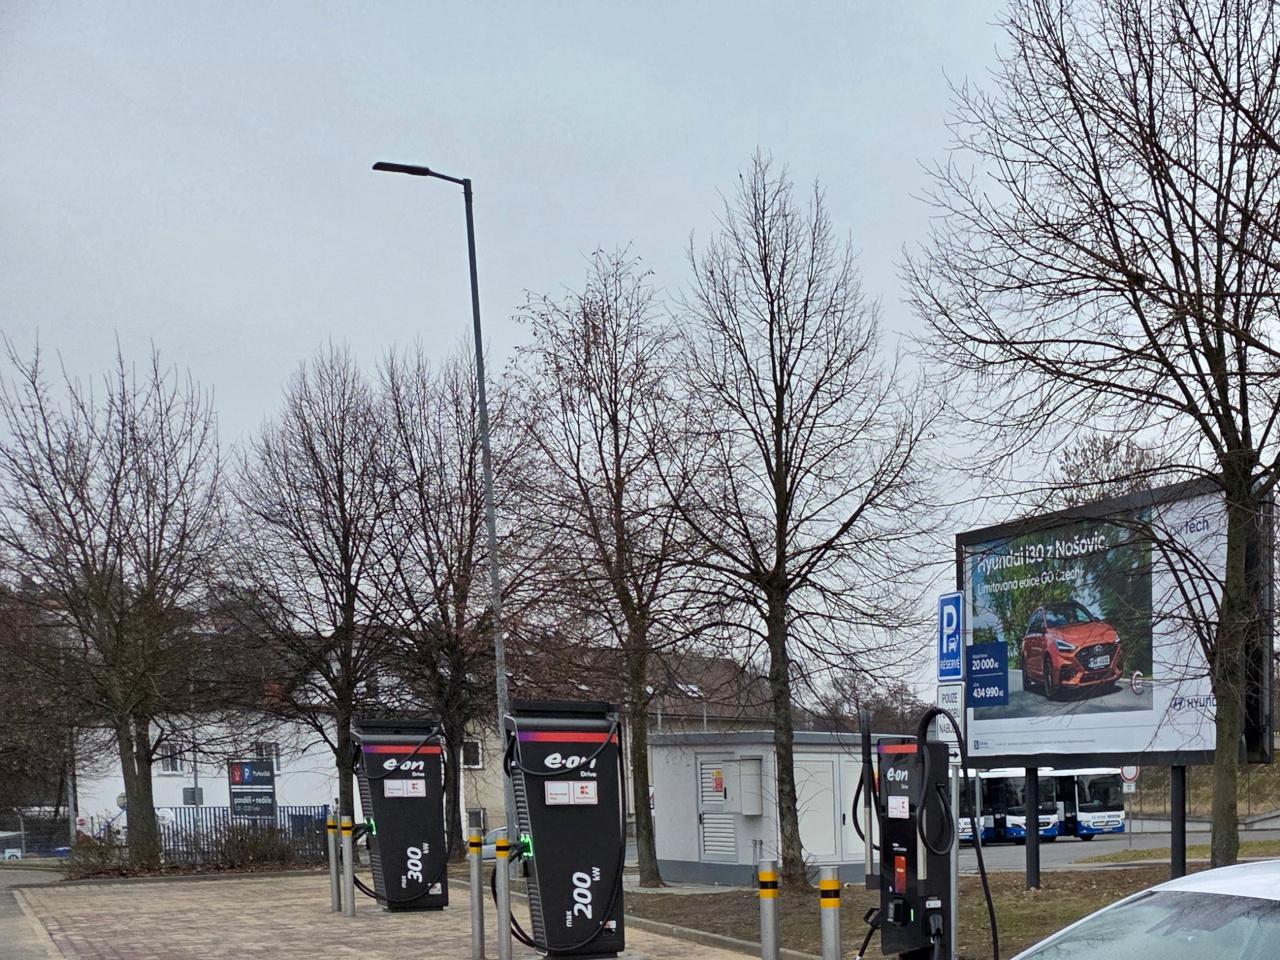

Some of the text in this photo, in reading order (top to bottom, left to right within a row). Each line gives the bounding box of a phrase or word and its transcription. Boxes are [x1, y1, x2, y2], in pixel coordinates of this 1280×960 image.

[580, 770, 597, 778] Drive
[407, 846, 423, 883] 300
[572, 872, 593, 919] 200
[592, 867, 600, 881] kW
